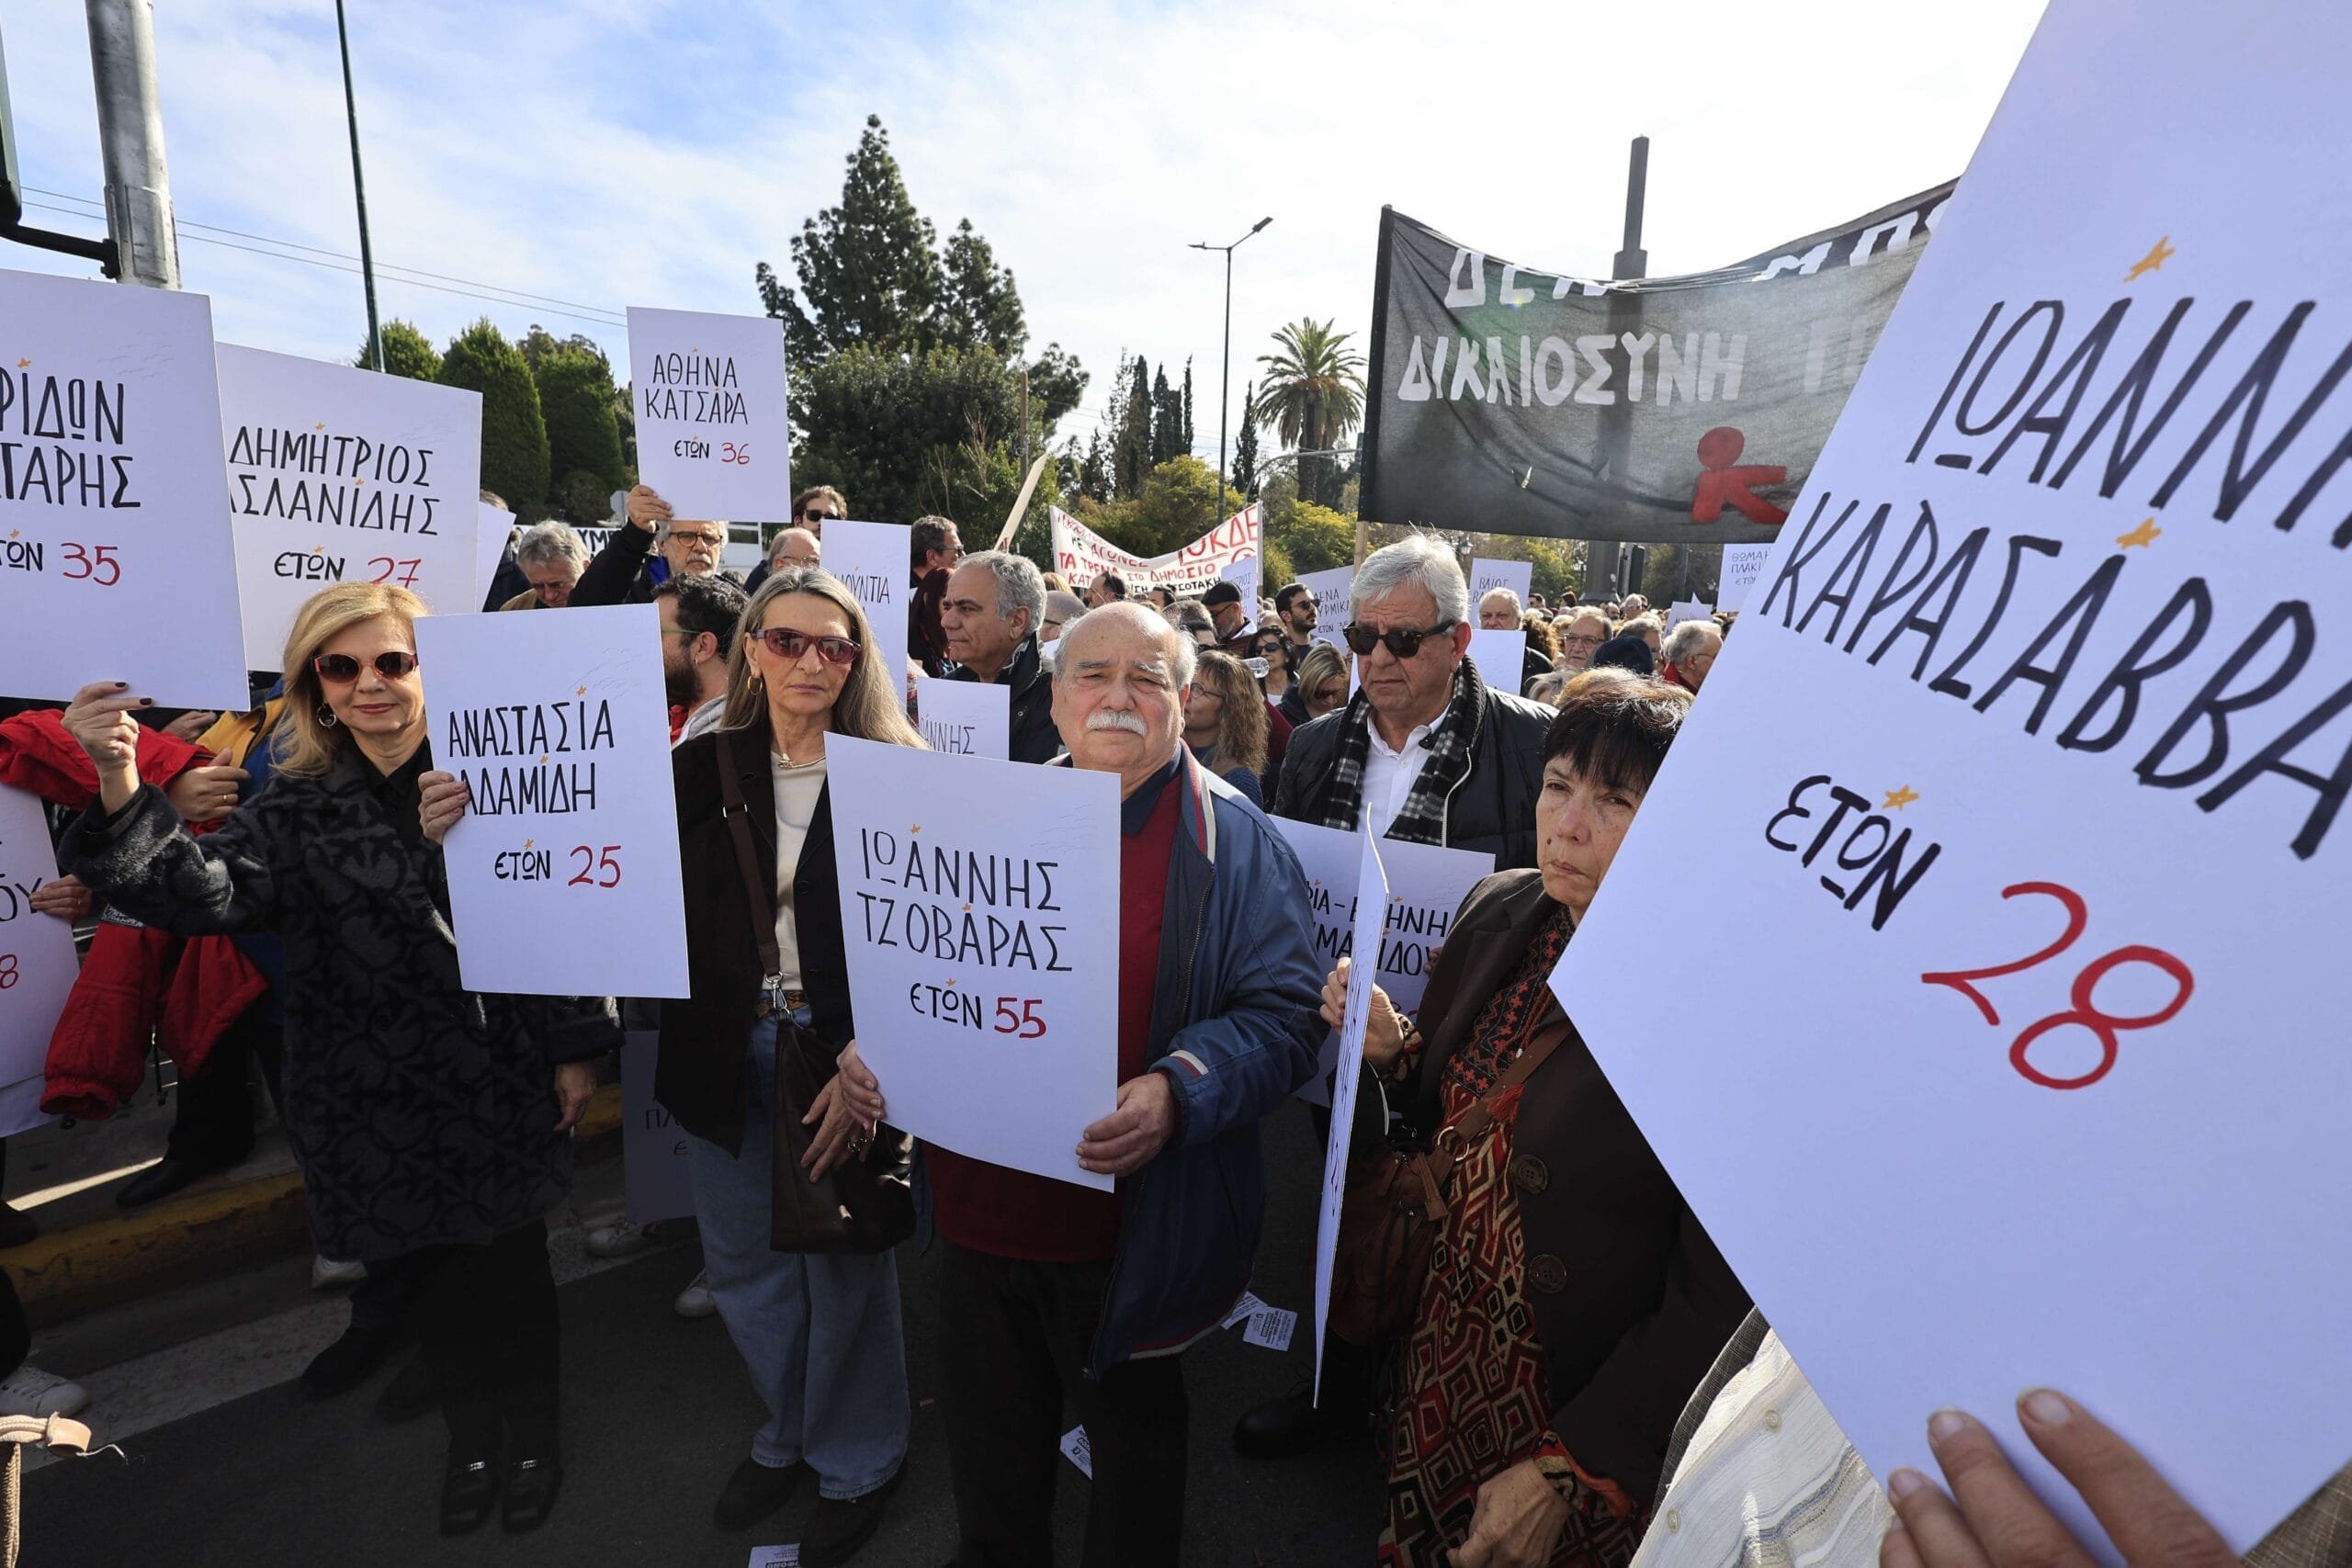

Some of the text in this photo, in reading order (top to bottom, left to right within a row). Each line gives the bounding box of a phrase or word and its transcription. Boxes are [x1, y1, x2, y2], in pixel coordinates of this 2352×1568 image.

[652, 352, 738, 389] ΑΘΗΝΑ
[1397, 331, 1746, 407] ΔΙΚΑΙΟΣΥΝΗ
[646, 389, 749, 424] ΚΑΤΣΑΡΑ
[0, 442, 141, 508] ΤΑΡΗΣ
[230, 426, 434, 487] ΔΗΜΗΤΡΙΟΣ
[674, 439, 751, 465] ΕΤΩΝ 36
[61, 542, 120, 586] 35
[275, 551, 422, 589] ΕΤΩΝ 27
[1059, 552, 1076, 570] ΤΑ
[1150, 563, 1216, 582] ΔΗΜΟΣΙΟ
[1173, 576, 1222, 592] ΣΟΤΑΚΗ
[449, 700, 615, 757] ΑΝΑΣΤΑΣΙΑ
[461, 762, 596, 816] ΑΔΑΜΙΔΗ
[494, 845, 622, 888] ΕΤΩΝ 25
[862, 829, 1061, 911] ΙΩΑΝΝΗΣ
[857, 892, 1073, 972] ΤΖΟΒΑΡΑΣ
[1765, 775, 2194, 1090] ΕΤΩΝ 28
[910, 983, 1046, 1038] ΕΤΩΝ 55
